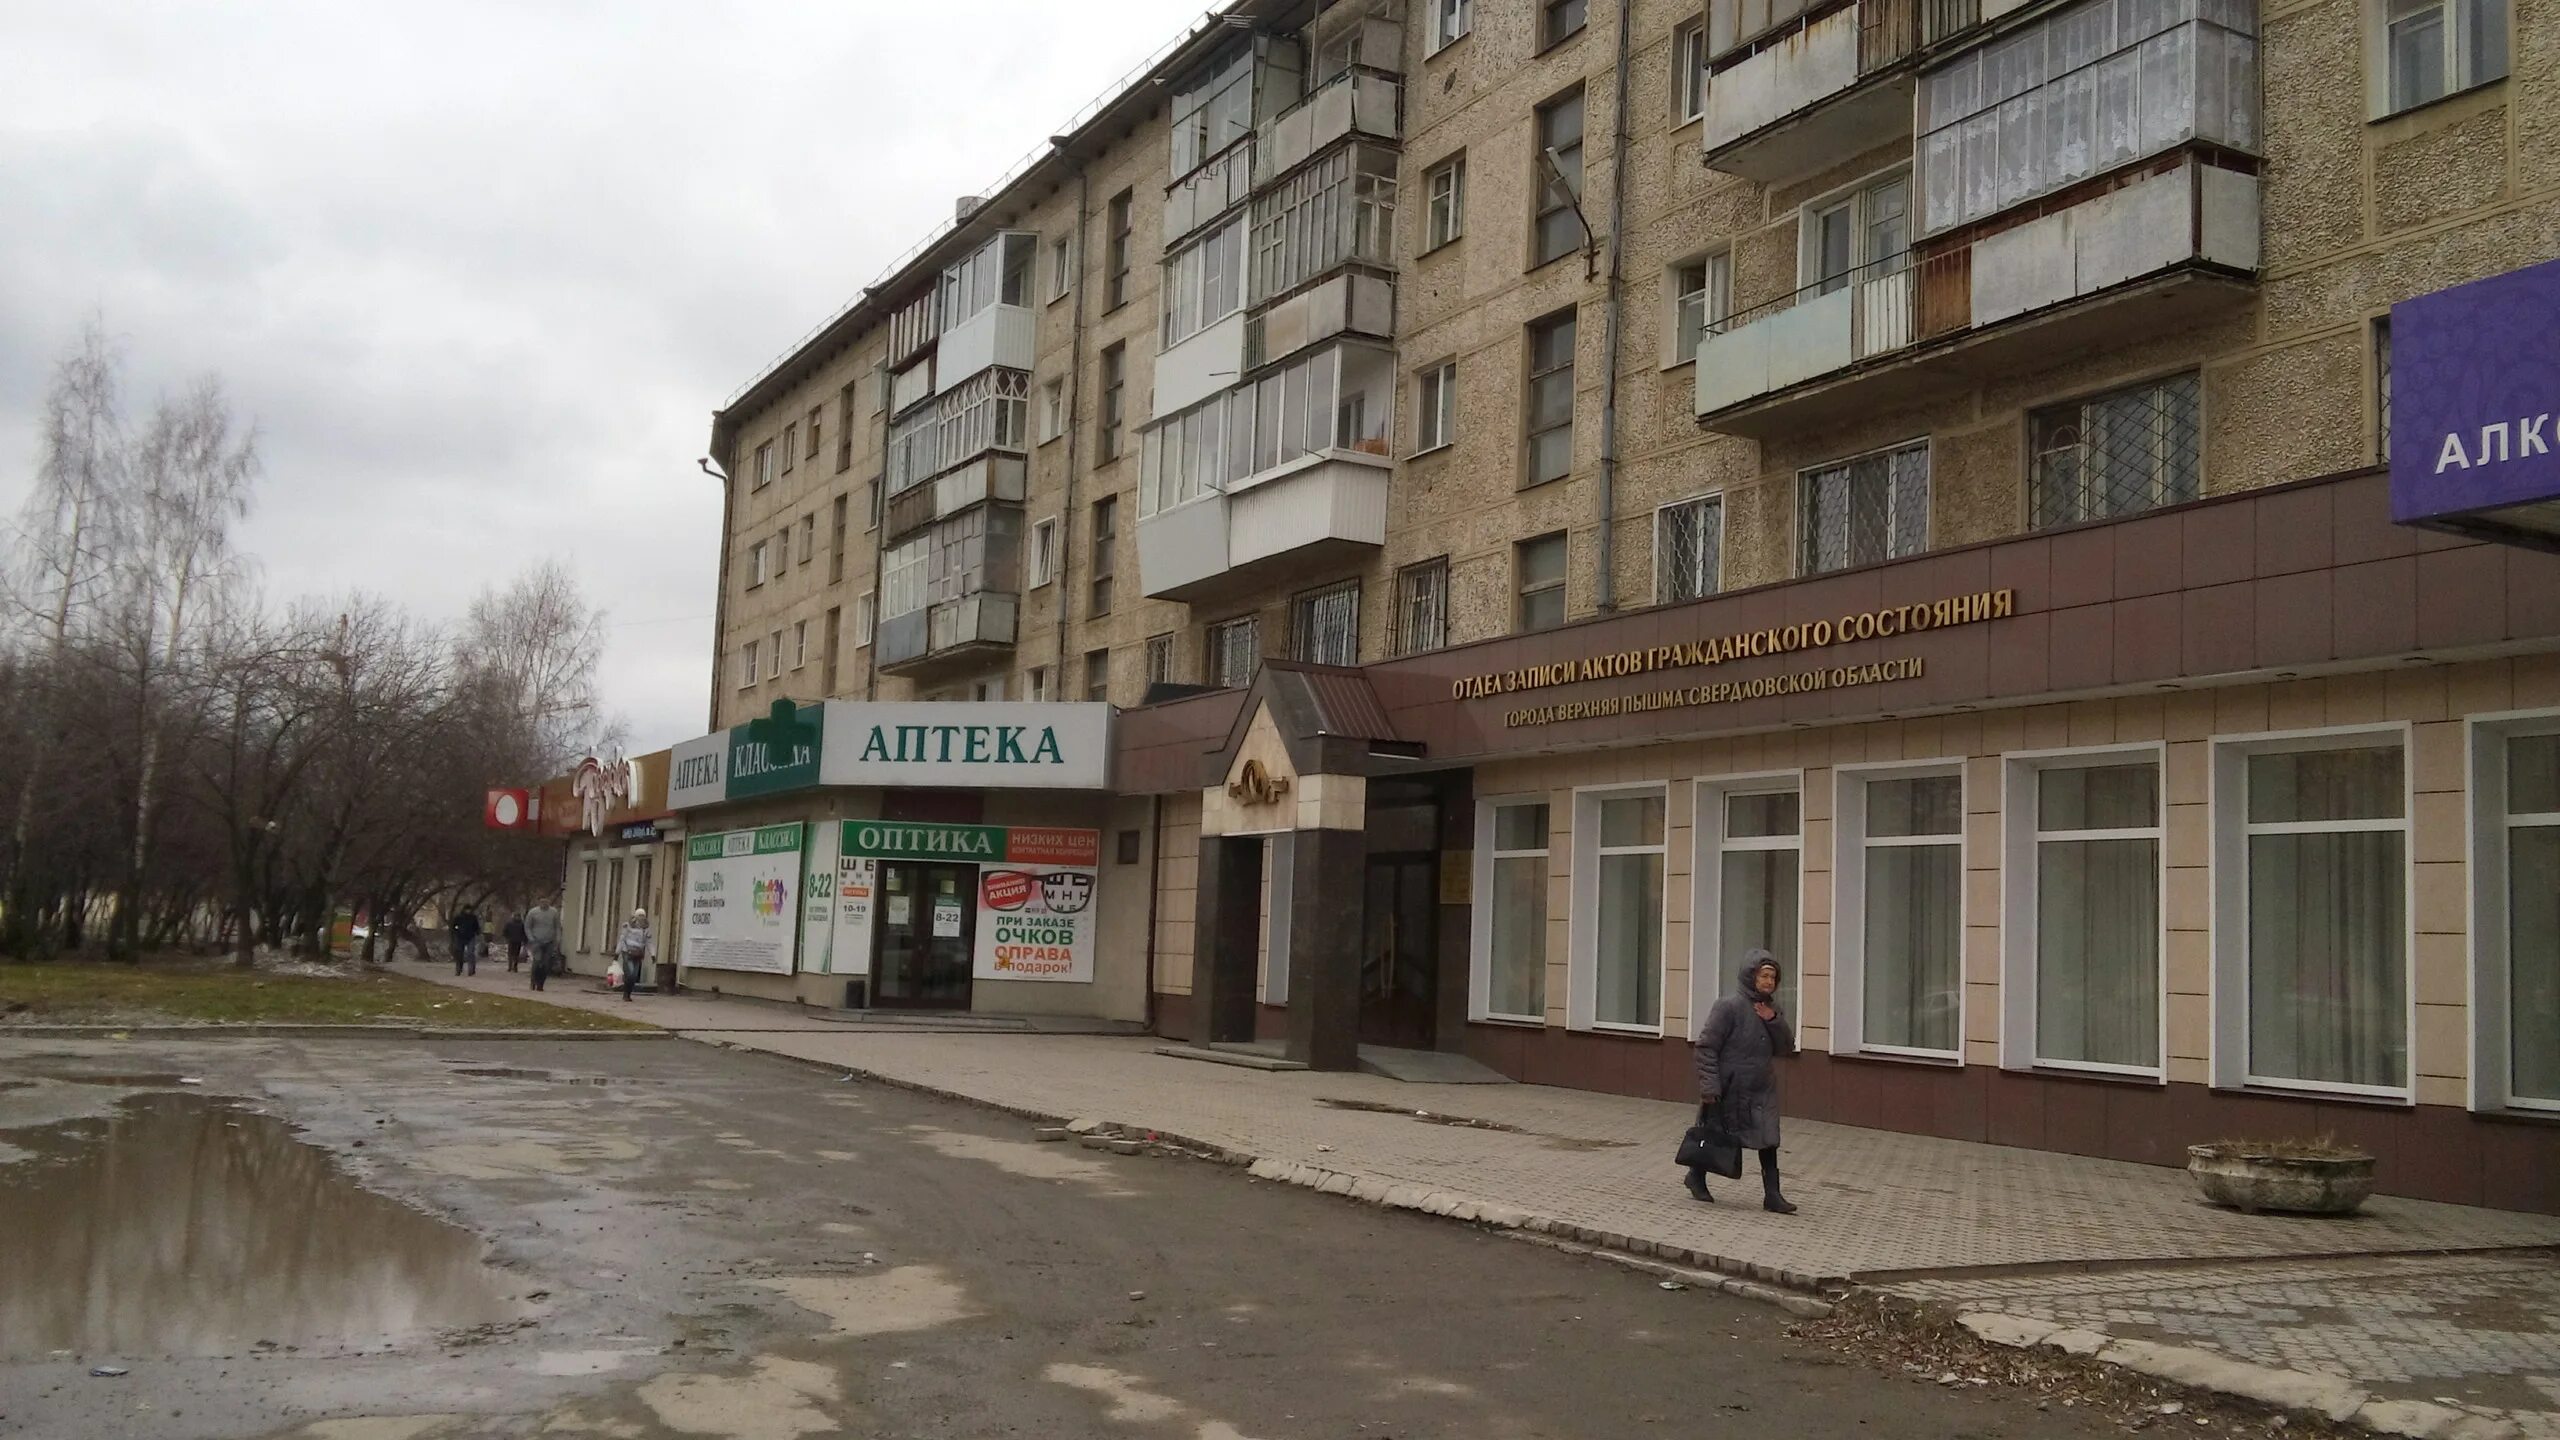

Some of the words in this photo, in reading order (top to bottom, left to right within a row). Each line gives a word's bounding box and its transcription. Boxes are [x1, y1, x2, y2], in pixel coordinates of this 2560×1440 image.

[2434, 413, 2560, 475] АЛК
[1452, 674, 1501, 700] ОТДЕЛ
[1505, 660, 1576, 692] ЗАПИСИ
[1580, 650, 1642, 681] АКТОВ
[1648, 619, 1832, 672] ГРАЖДАНСКОГО
[1837, 588, 2013, 643] СОСТОЯНИЯ
[1504, 706, 1555, 728] ГОРОДА
[1557, 696, 1620, 722] ВЕРХНЯЯ
[1622, 689, 1685, 713] ПЫШМА
[1689, 667, 1827, 705] СВЕРДЛОВСКОЙ
[1832, 656, 1923, 688] ОБЛАСТИ
[859, 725, 1065, 764] АПТЕКА
[673, 752, 719, 791] АПТЕКА
[858, 827, 993, 854] ОПТИКА
[841, 858, 857, 870] Ш
[808, 872, 832, 899] 8-22
[988, 884, 1027, 900] АКЦИЯ
[843, 904, 866, 913] 10-19
[935, 912, 959, 923] 8-22
[996, 916, 1022, 926] ПРИ
[1026, 917, 1075, 928] ЗАКАЗЕ
[995, 927, 1074, 945] ОЧКОВ
[994, 945, 1072, 961] ОПРАВА
[1009, 962, 1073, 975] подарок!
